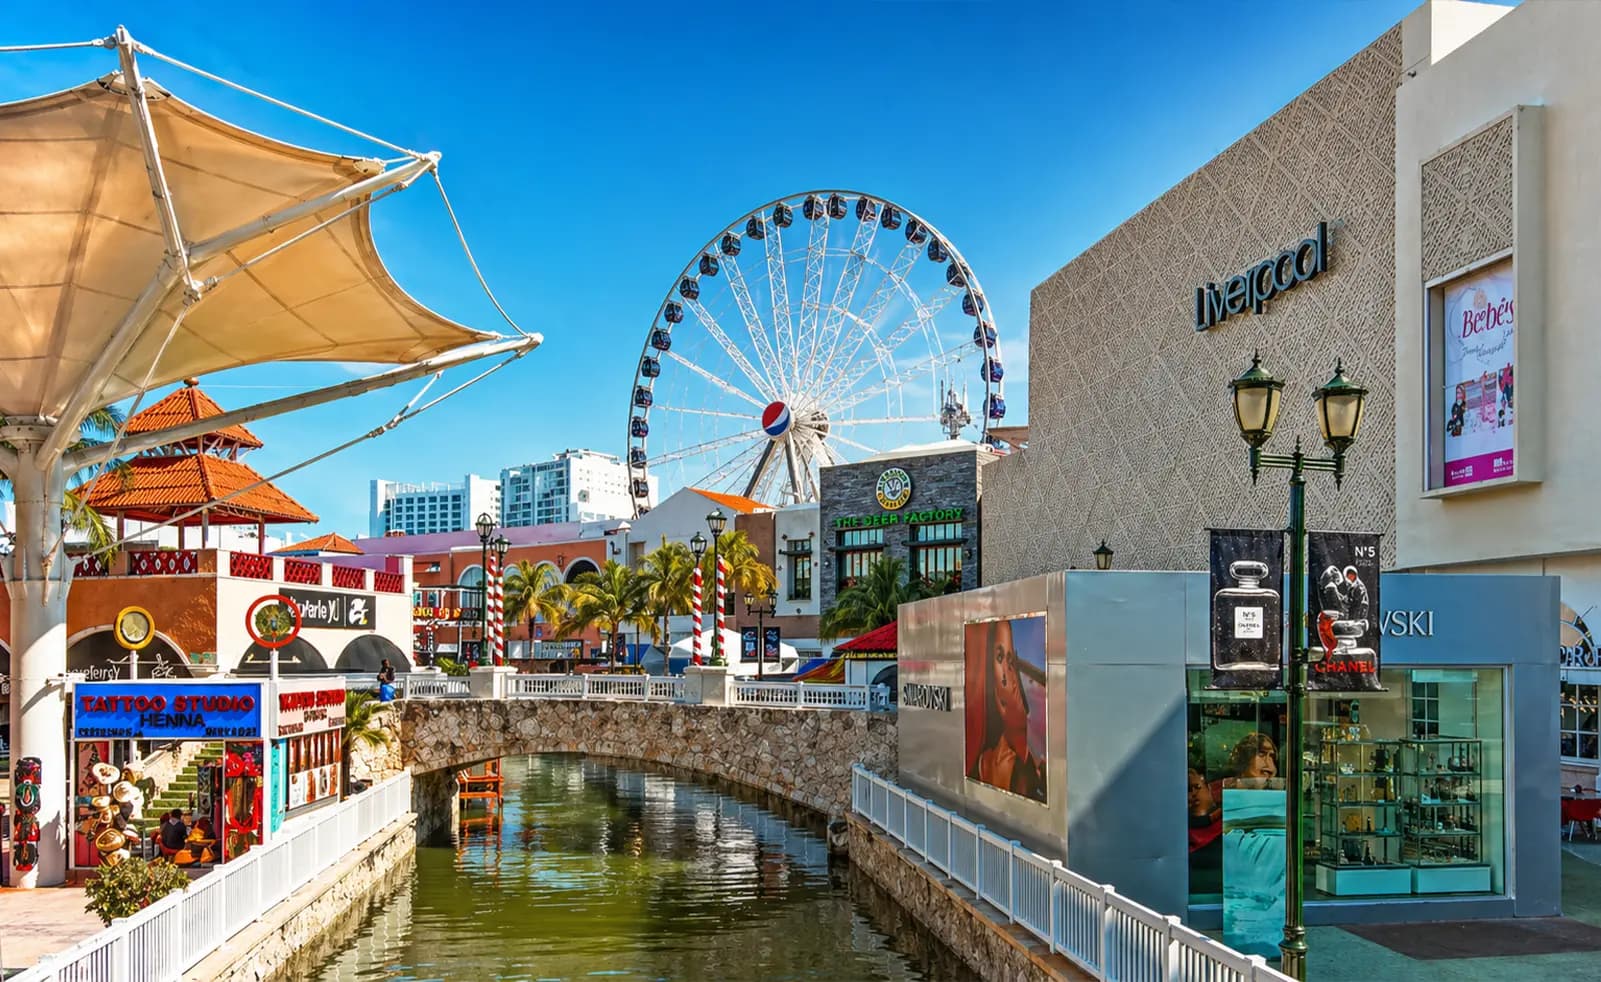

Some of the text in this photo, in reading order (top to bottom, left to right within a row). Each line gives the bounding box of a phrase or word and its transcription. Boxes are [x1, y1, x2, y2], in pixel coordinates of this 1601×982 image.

[1195, 221, 1328, 332] Liverpool
[903, 508, 964, 524] FACTORY
[1379, 610, 1434, 637] VSKI
[1315, 660, 1376, 674] CHANEL
[80, 695, 256, 713] TATTOO STUDIO
[139, 713, 206, 728] HENNA
